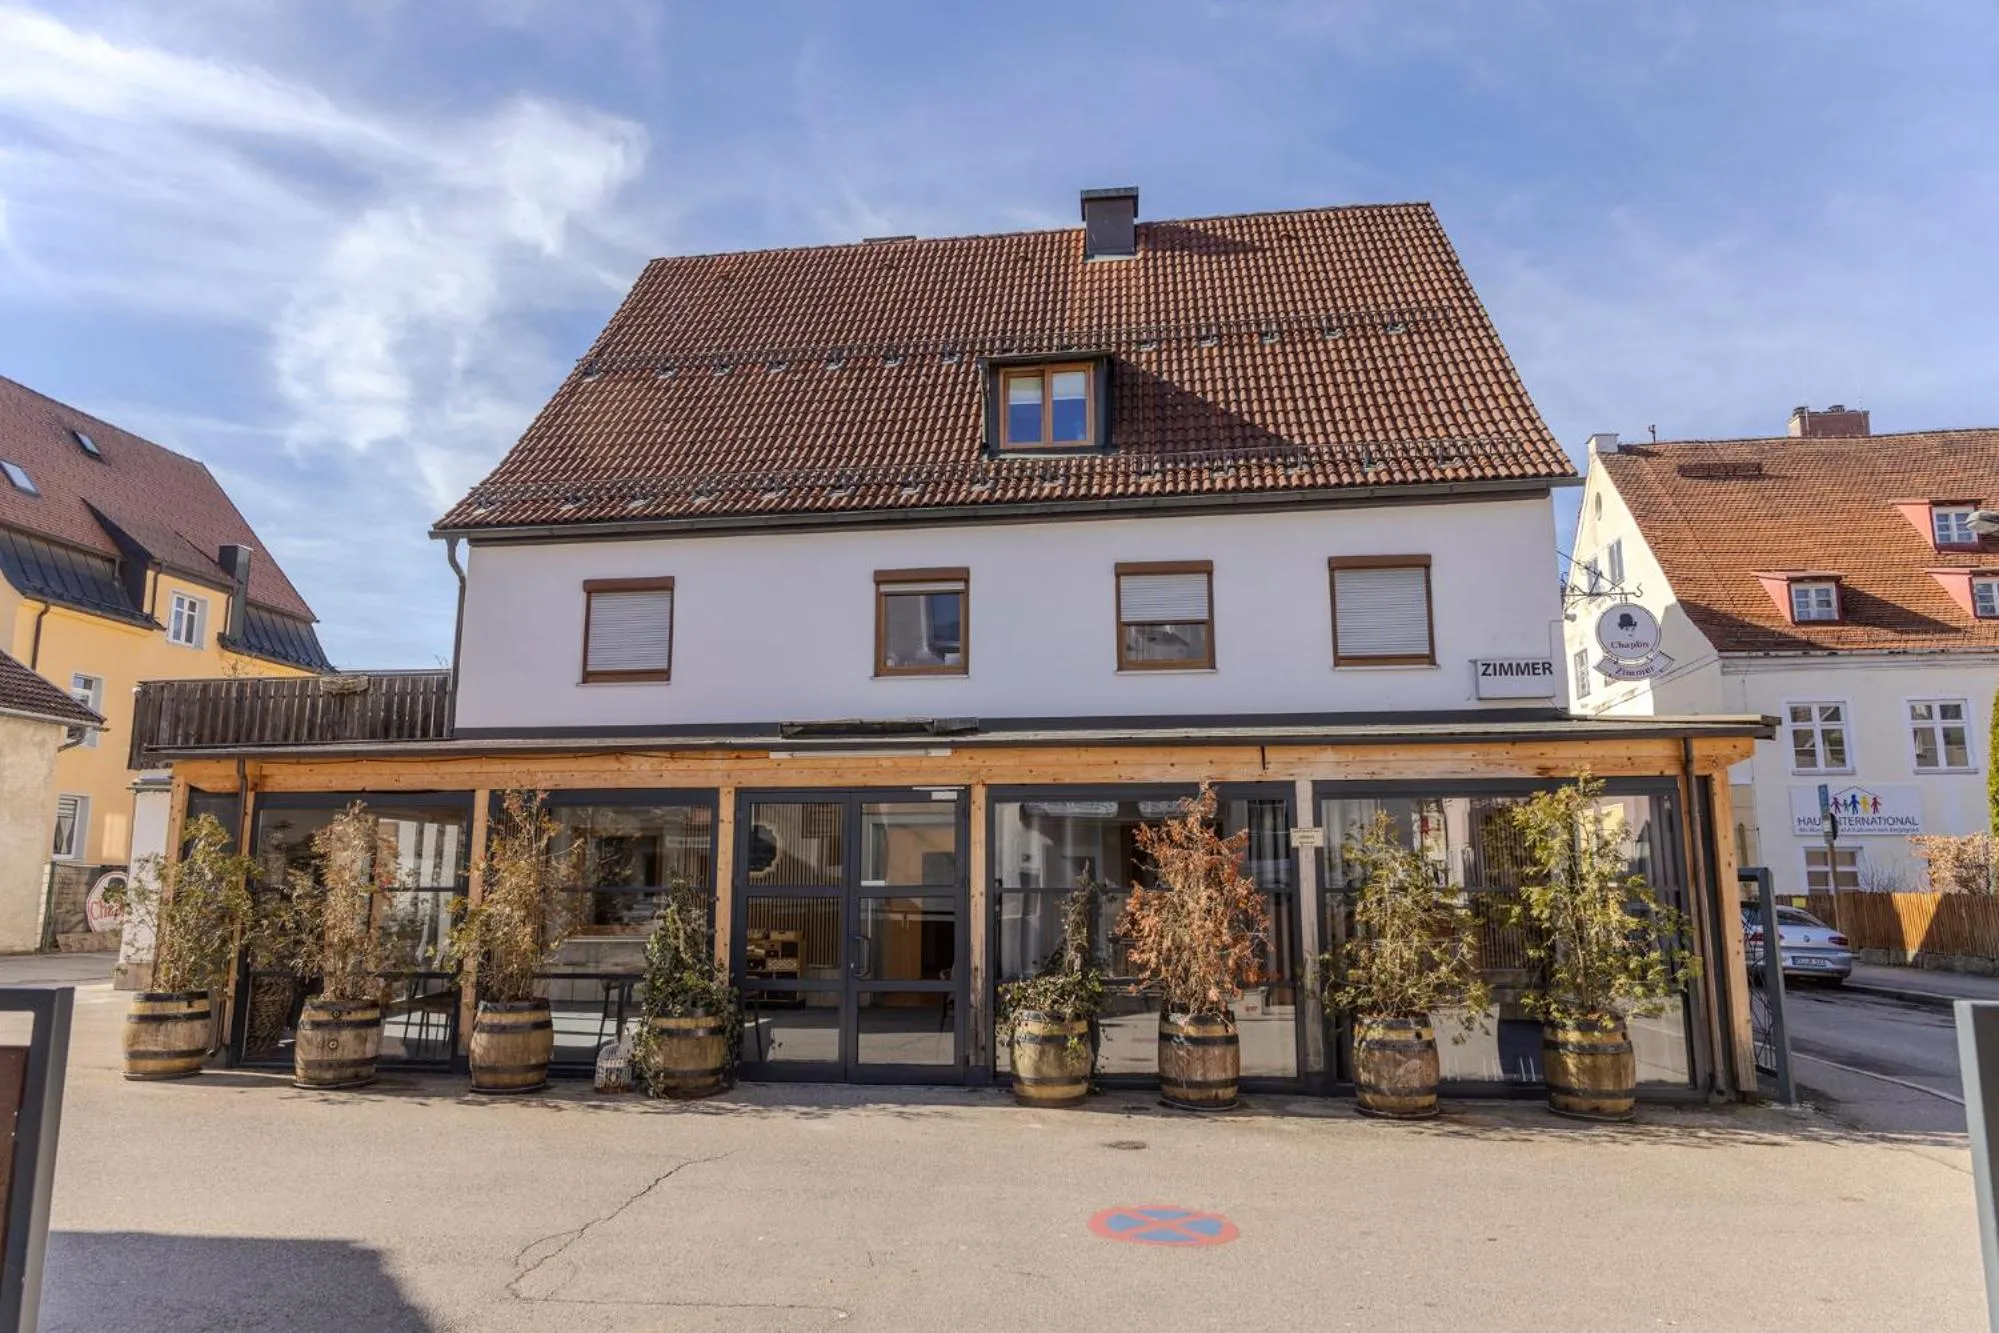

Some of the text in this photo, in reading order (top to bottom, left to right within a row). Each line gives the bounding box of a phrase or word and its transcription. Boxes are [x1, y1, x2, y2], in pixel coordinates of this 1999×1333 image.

[1610, 640, 1650, 651] Chaplin
[1481, 661, 1553, 677] ZIMMER
[1614, 664, 1656, 677] Zimmer
[1797, 816, 1919, 827] HAU NTERNATIONAL
